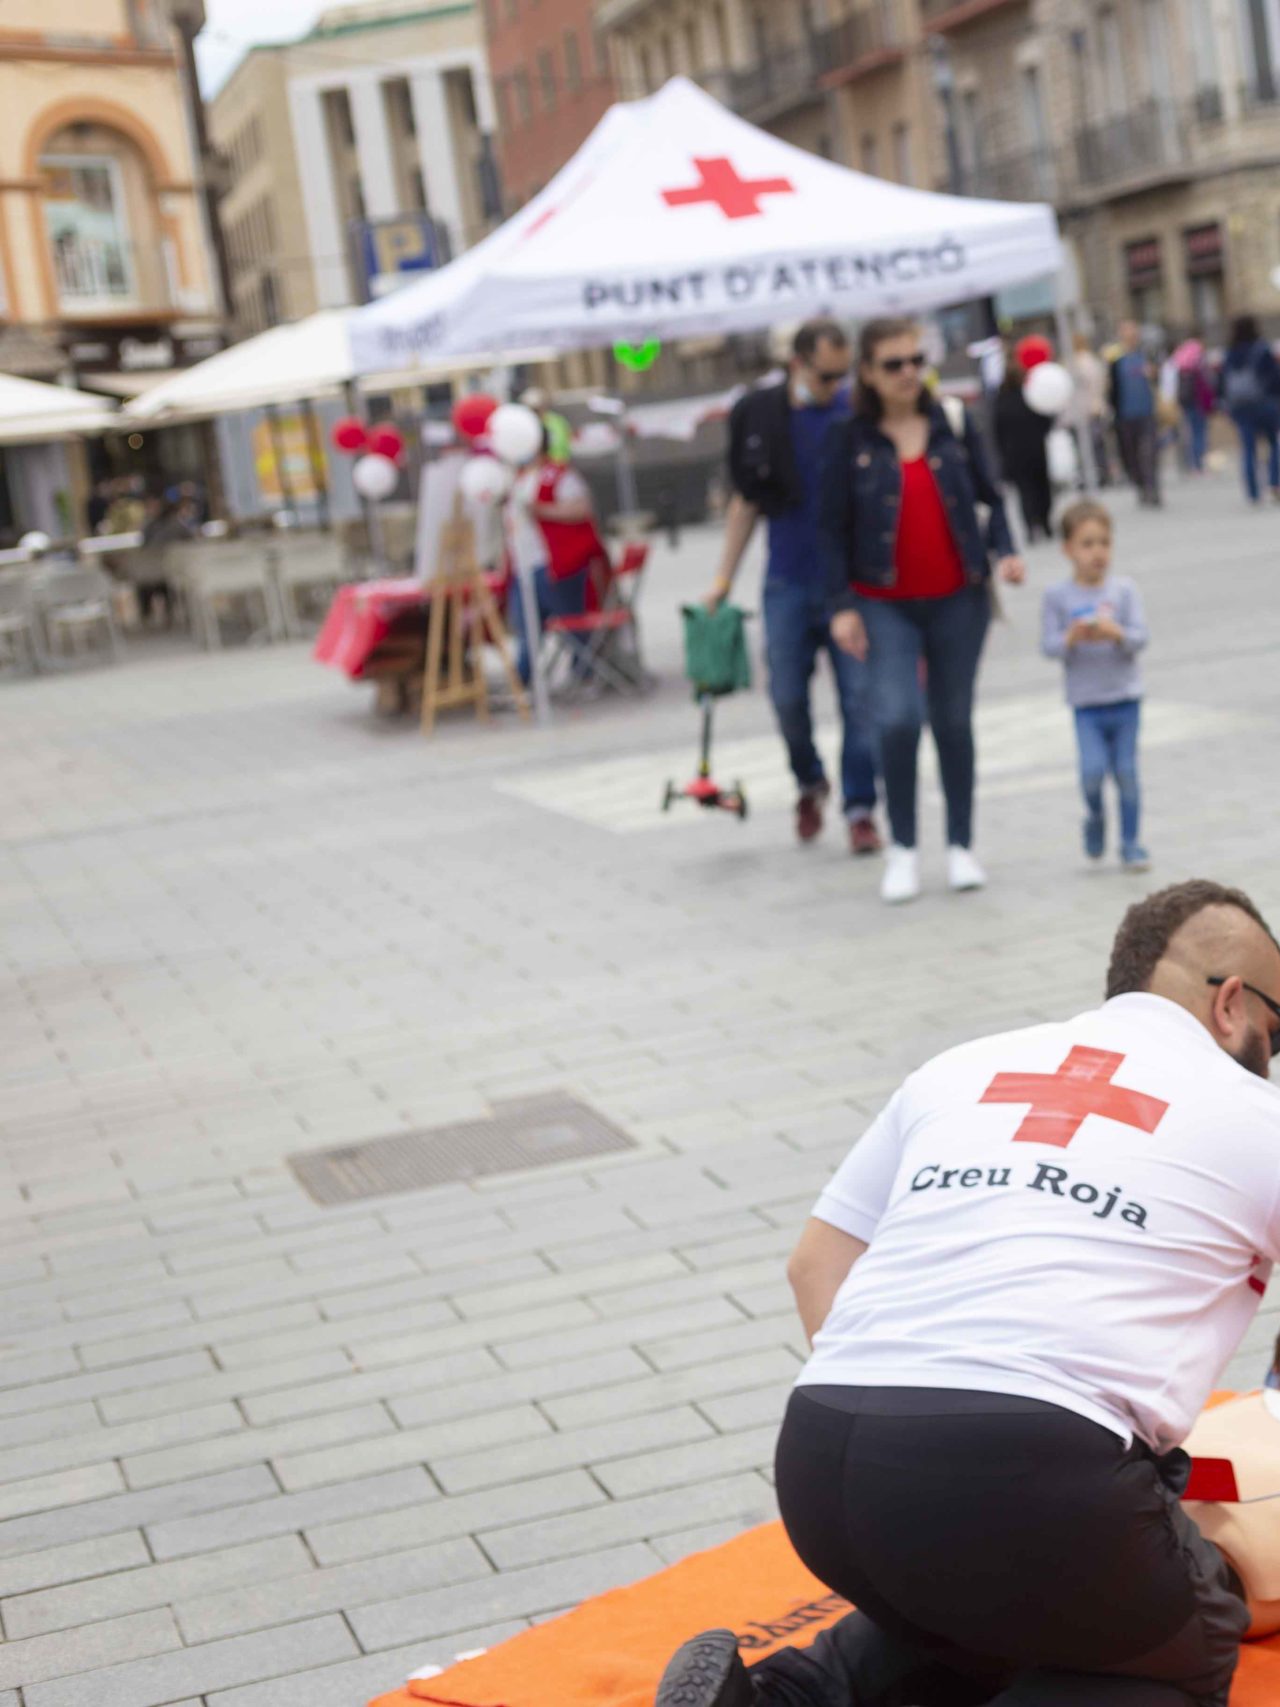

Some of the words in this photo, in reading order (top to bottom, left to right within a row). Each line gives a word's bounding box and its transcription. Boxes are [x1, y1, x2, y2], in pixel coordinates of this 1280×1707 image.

[376, 222, 424, 273] P
[583, 270, 709, 308] PUNT
[723, 232, 967, 299] D'ATENCIÓ
[911, 1163, 1012, 1192] Creu
[1026, 1163, 1148, 1230] Roja
